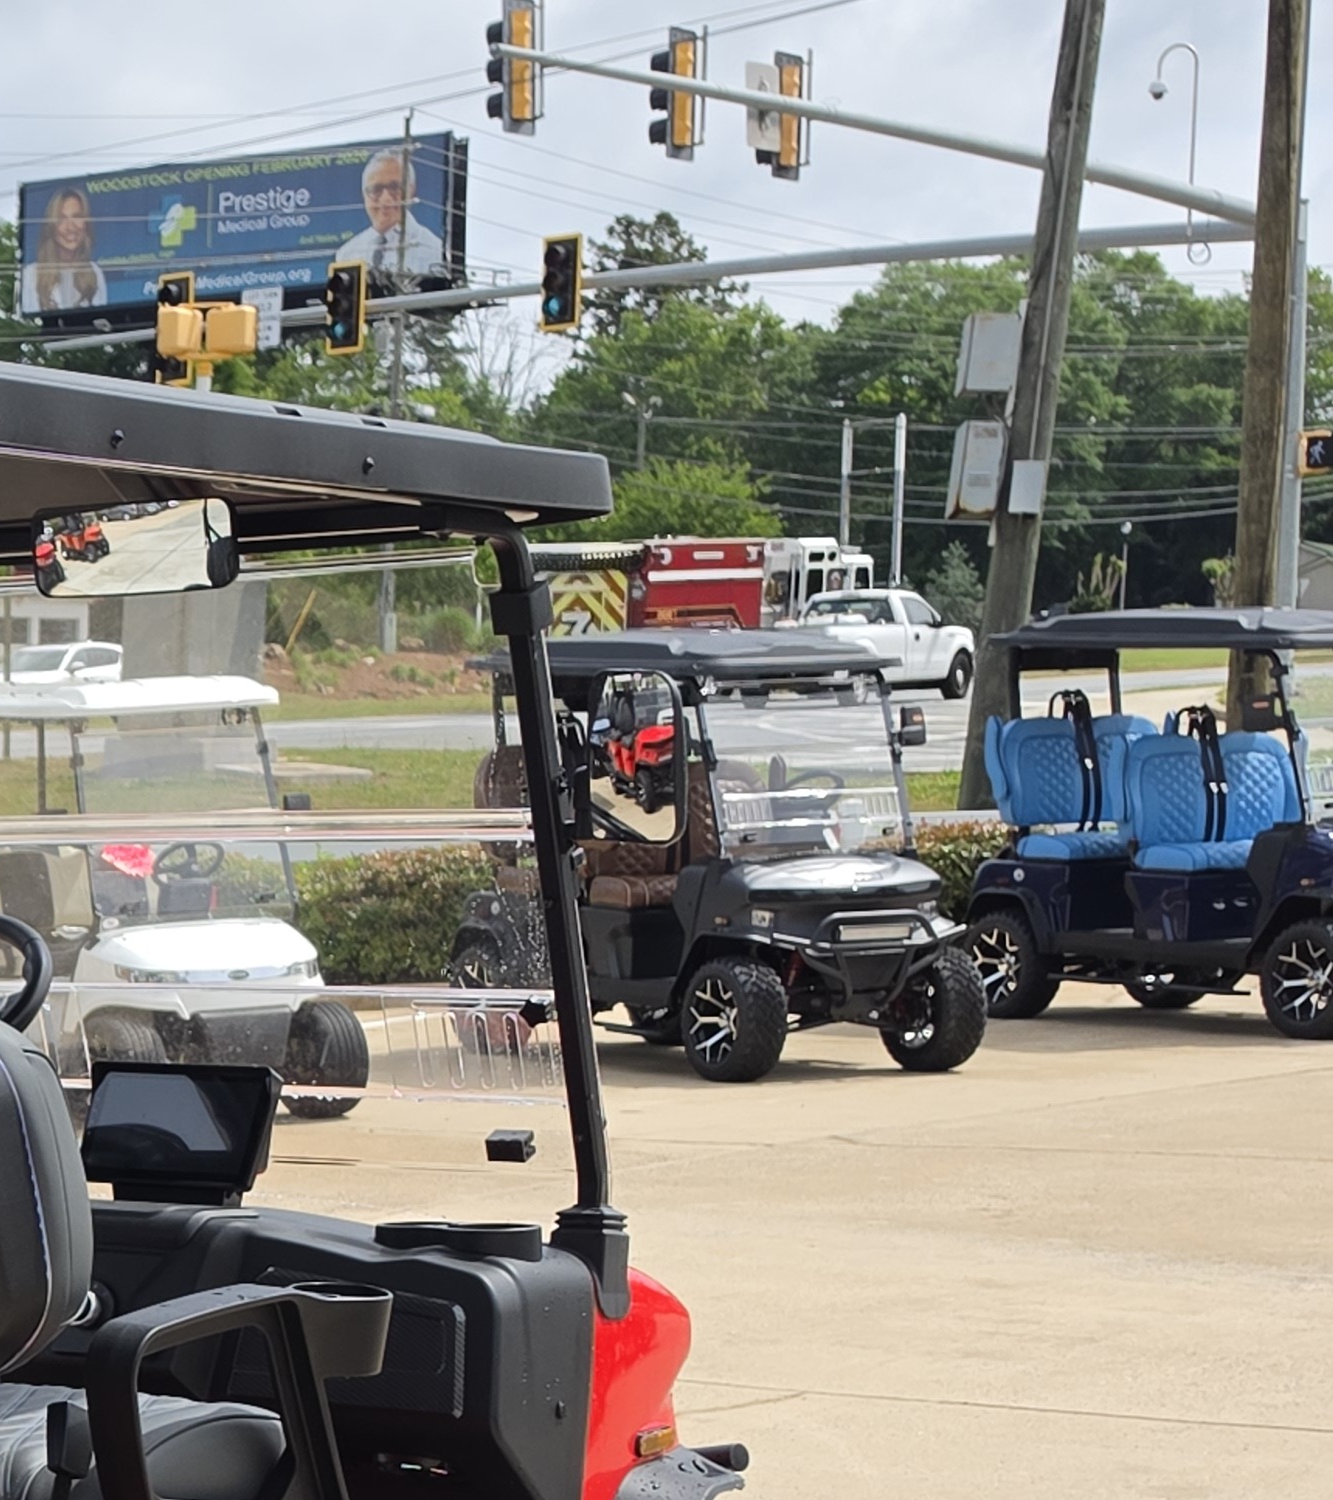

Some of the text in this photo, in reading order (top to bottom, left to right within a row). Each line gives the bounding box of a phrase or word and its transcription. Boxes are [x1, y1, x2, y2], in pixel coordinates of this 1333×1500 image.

[218, 187, 311, 215] Prestige
[217, 214, 311, 234] Medical Group
